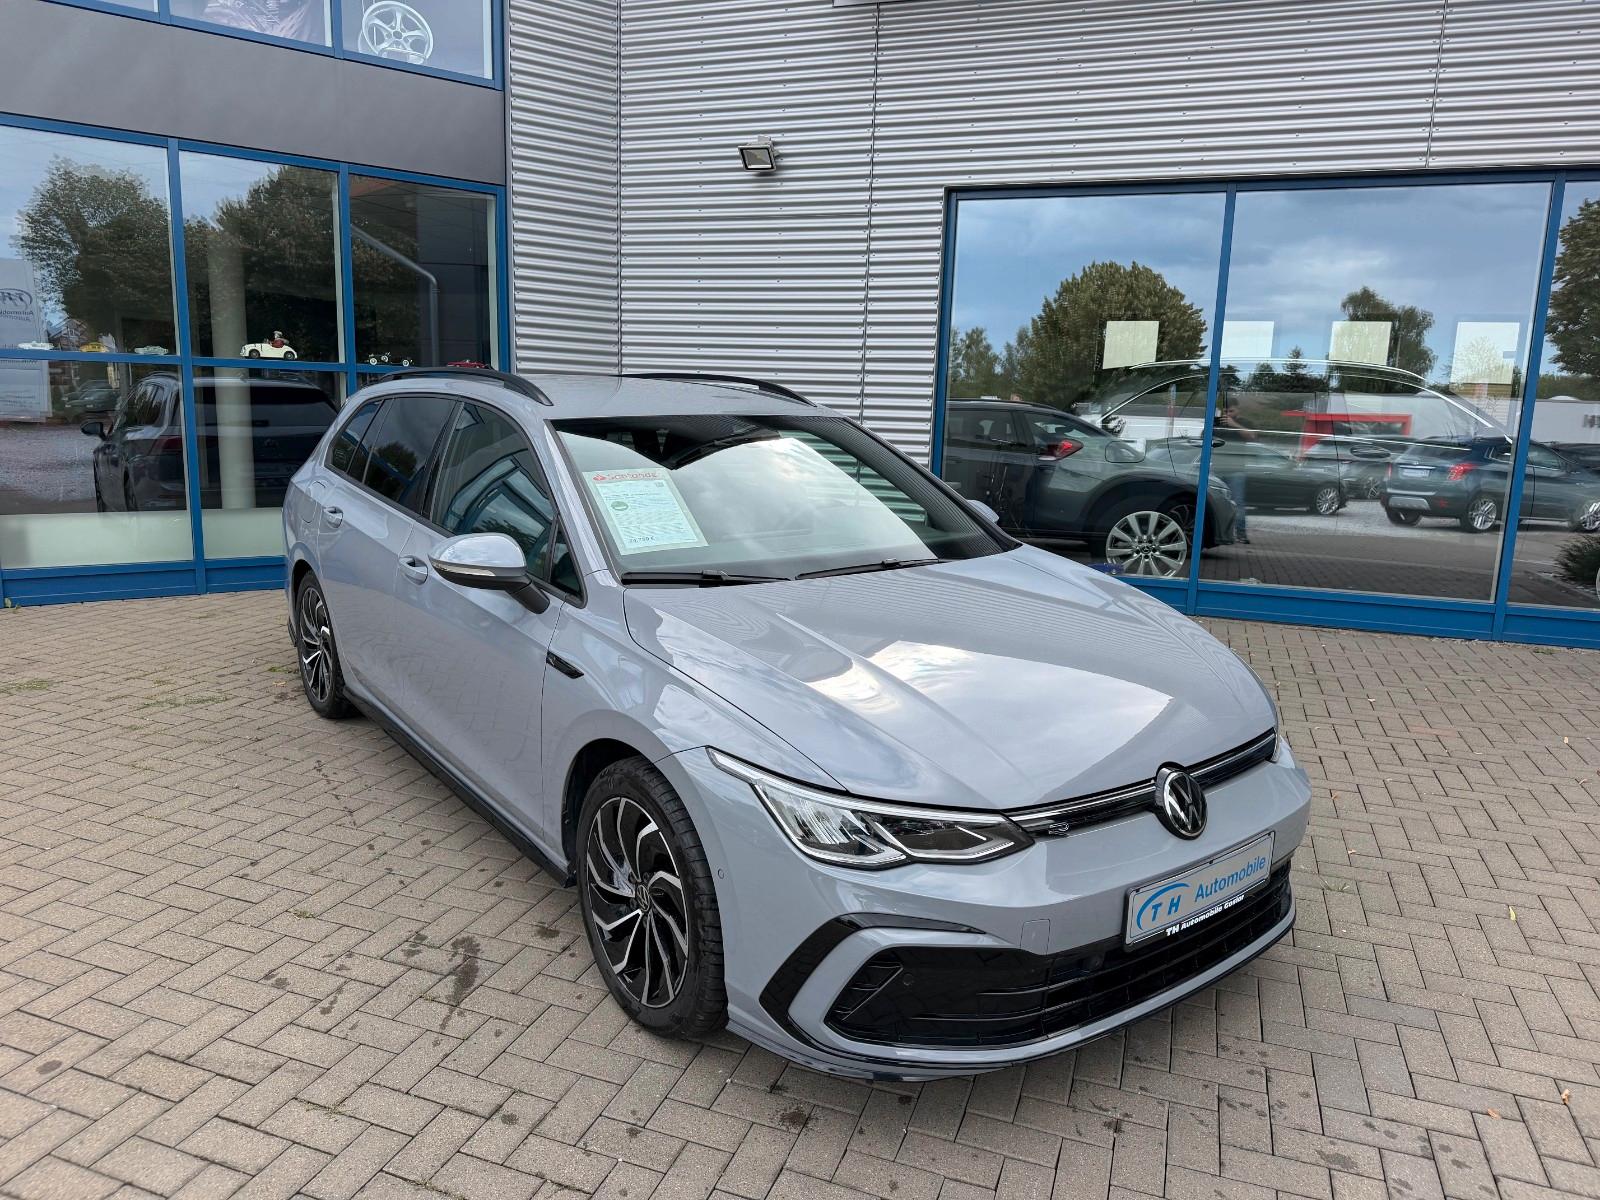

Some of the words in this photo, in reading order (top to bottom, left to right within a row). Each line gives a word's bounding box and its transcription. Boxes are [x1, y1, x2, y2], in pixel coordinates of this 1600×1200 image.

[1194, 855, 1266, 902] Automobile
[1166, 922, 1180, 936] TH
[1180, 903, 1223, 930] Automobile
[1223, 893, 1244, 910] Goslar
